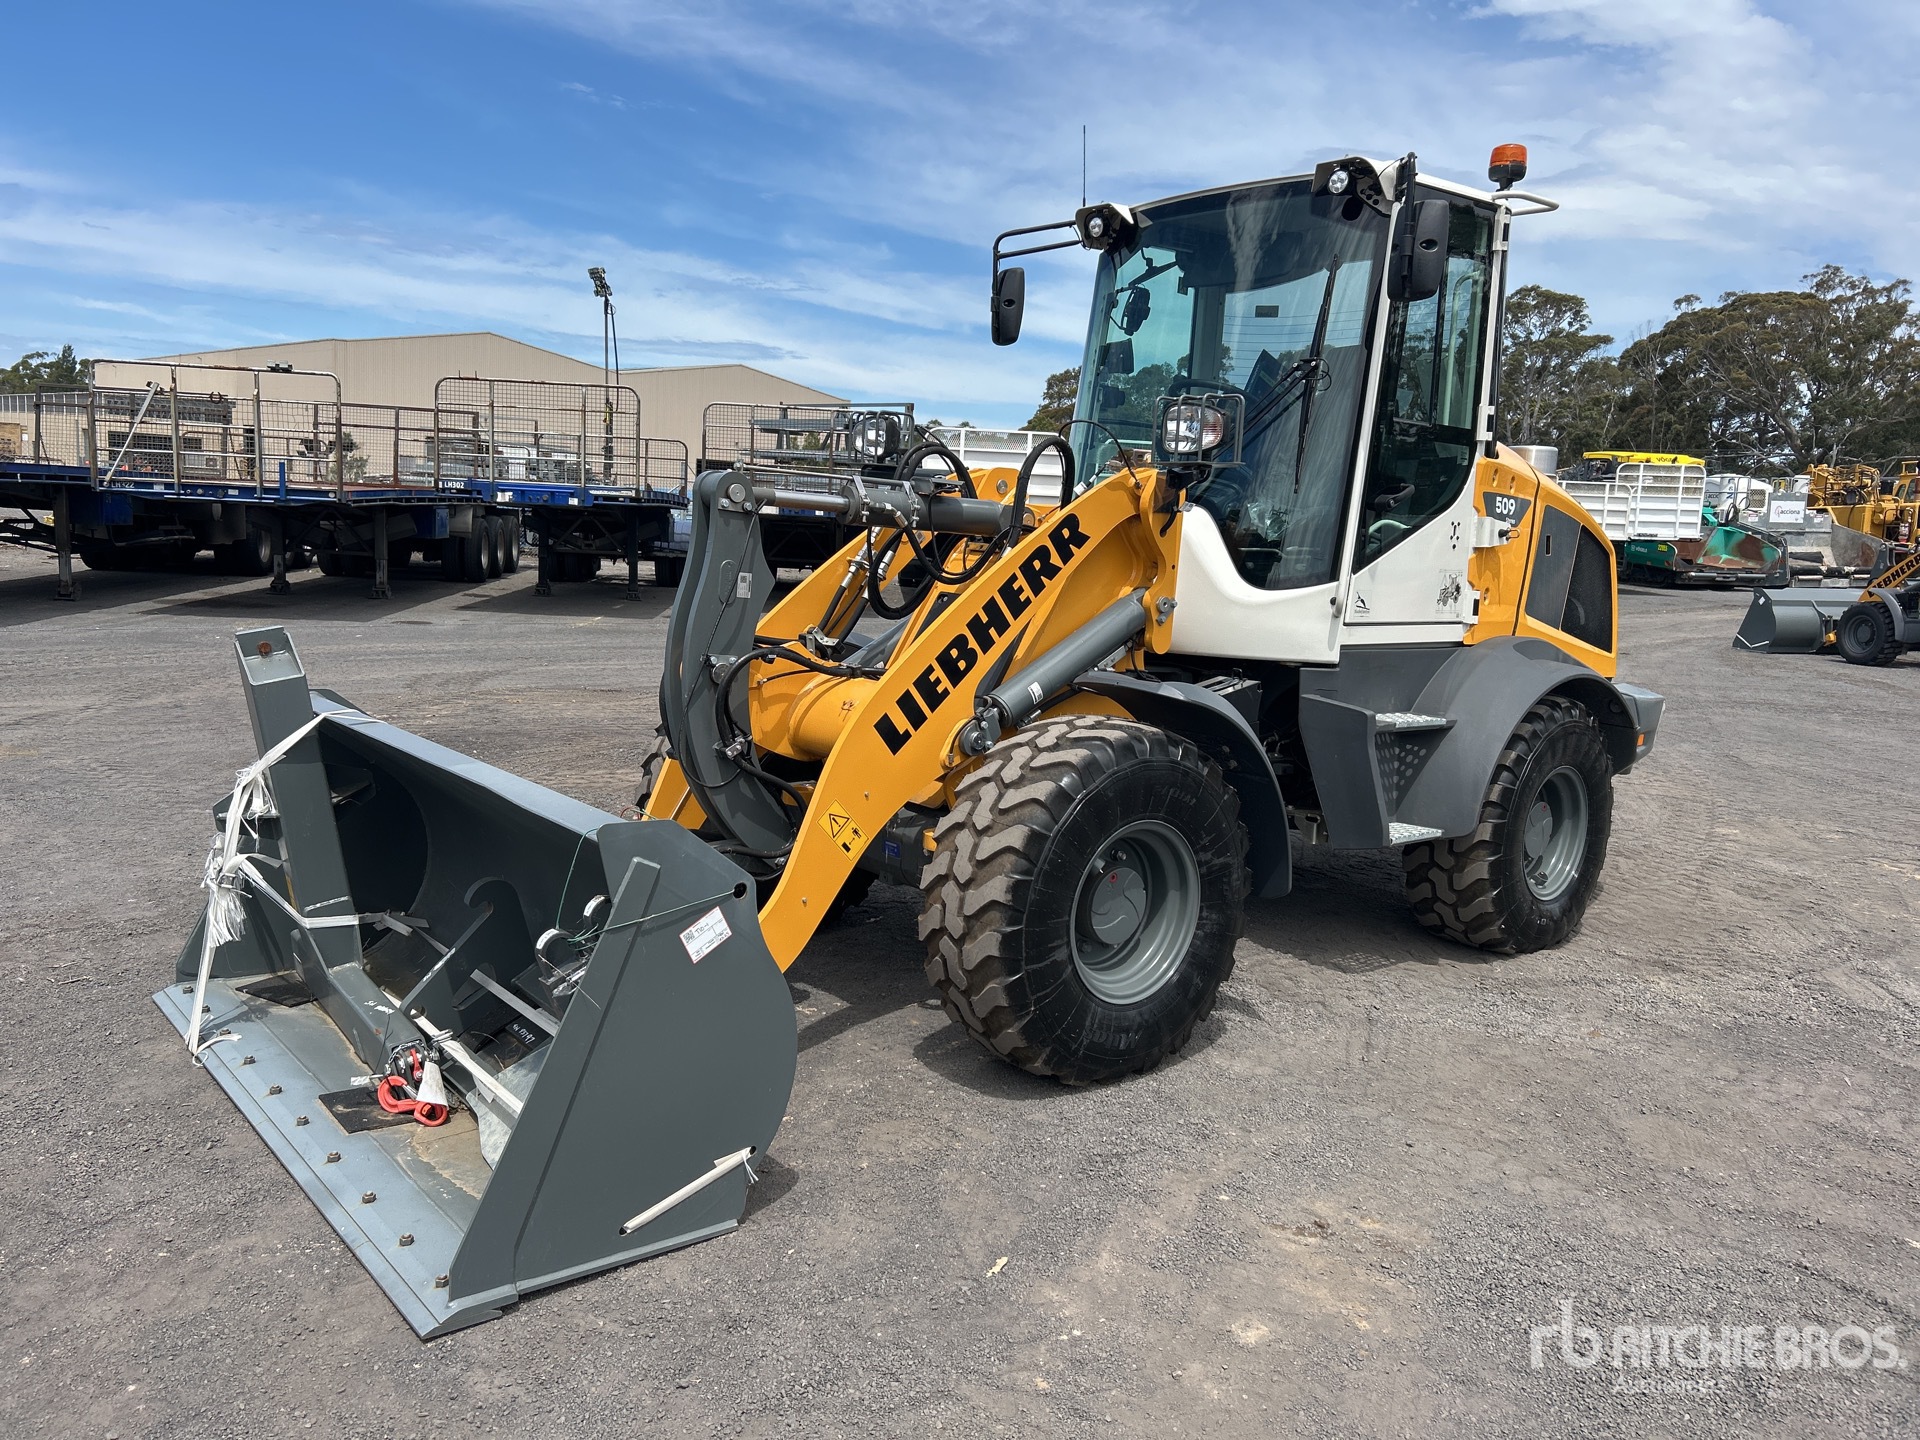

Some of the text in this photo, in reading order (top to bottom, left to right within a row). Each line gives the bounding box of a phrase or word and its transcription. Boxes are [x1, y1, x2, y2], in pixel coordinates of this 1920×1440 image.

[444, 481, 465, 489] LH302
[1495, 496, 1516, 516] 509
[1866, 553, 1920, 598] LEBHERR
[873, 513, 1091, 756] LIEBHERR
